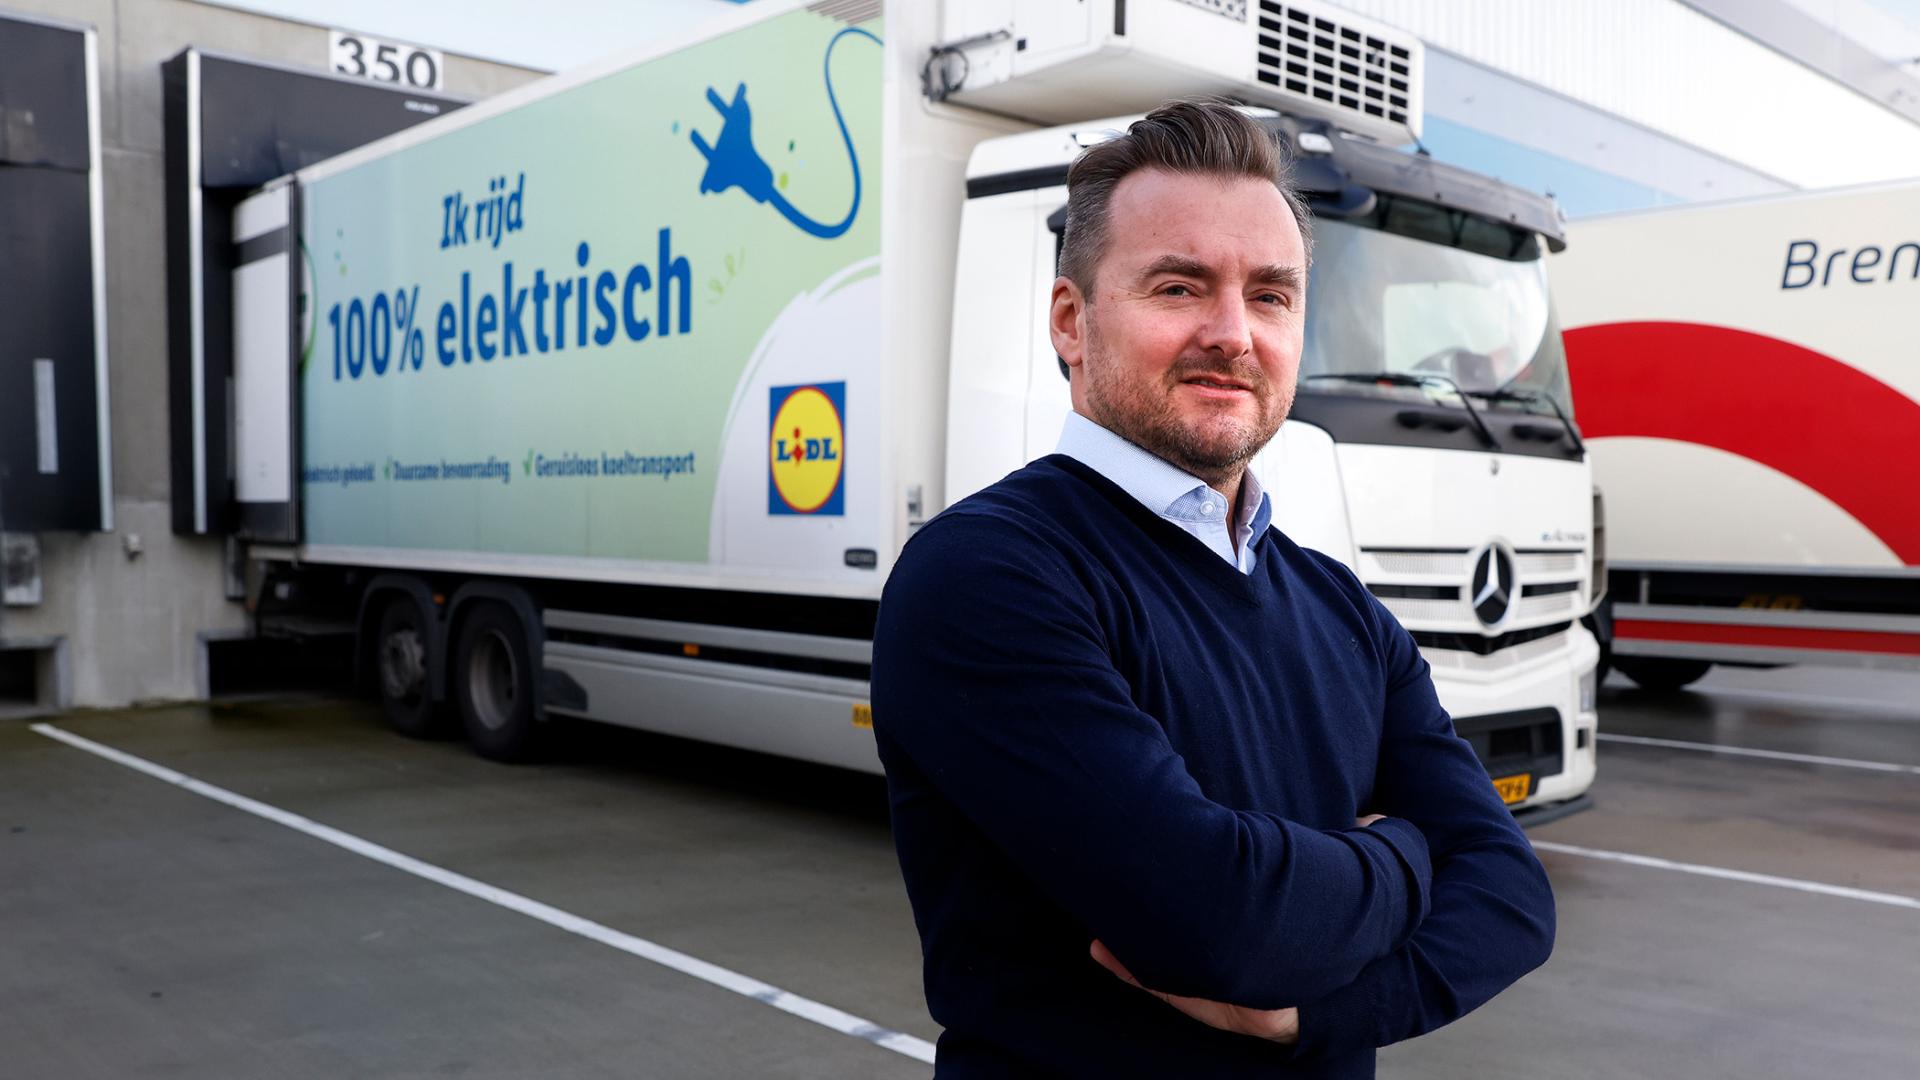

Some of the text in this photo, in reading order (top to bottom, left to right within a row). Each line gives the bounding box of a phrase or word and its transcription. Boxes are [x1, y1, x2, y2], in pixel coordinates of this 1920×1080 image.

[336, 36, 437, 88] 350
[440, 172, 525, 250] Ik rijd
[1781, 239, 1920, 290] Bren
[328, 226, 693, 382] 100% elektrisch
[535, 449, 696, 482] Geruisloos koeltransport
